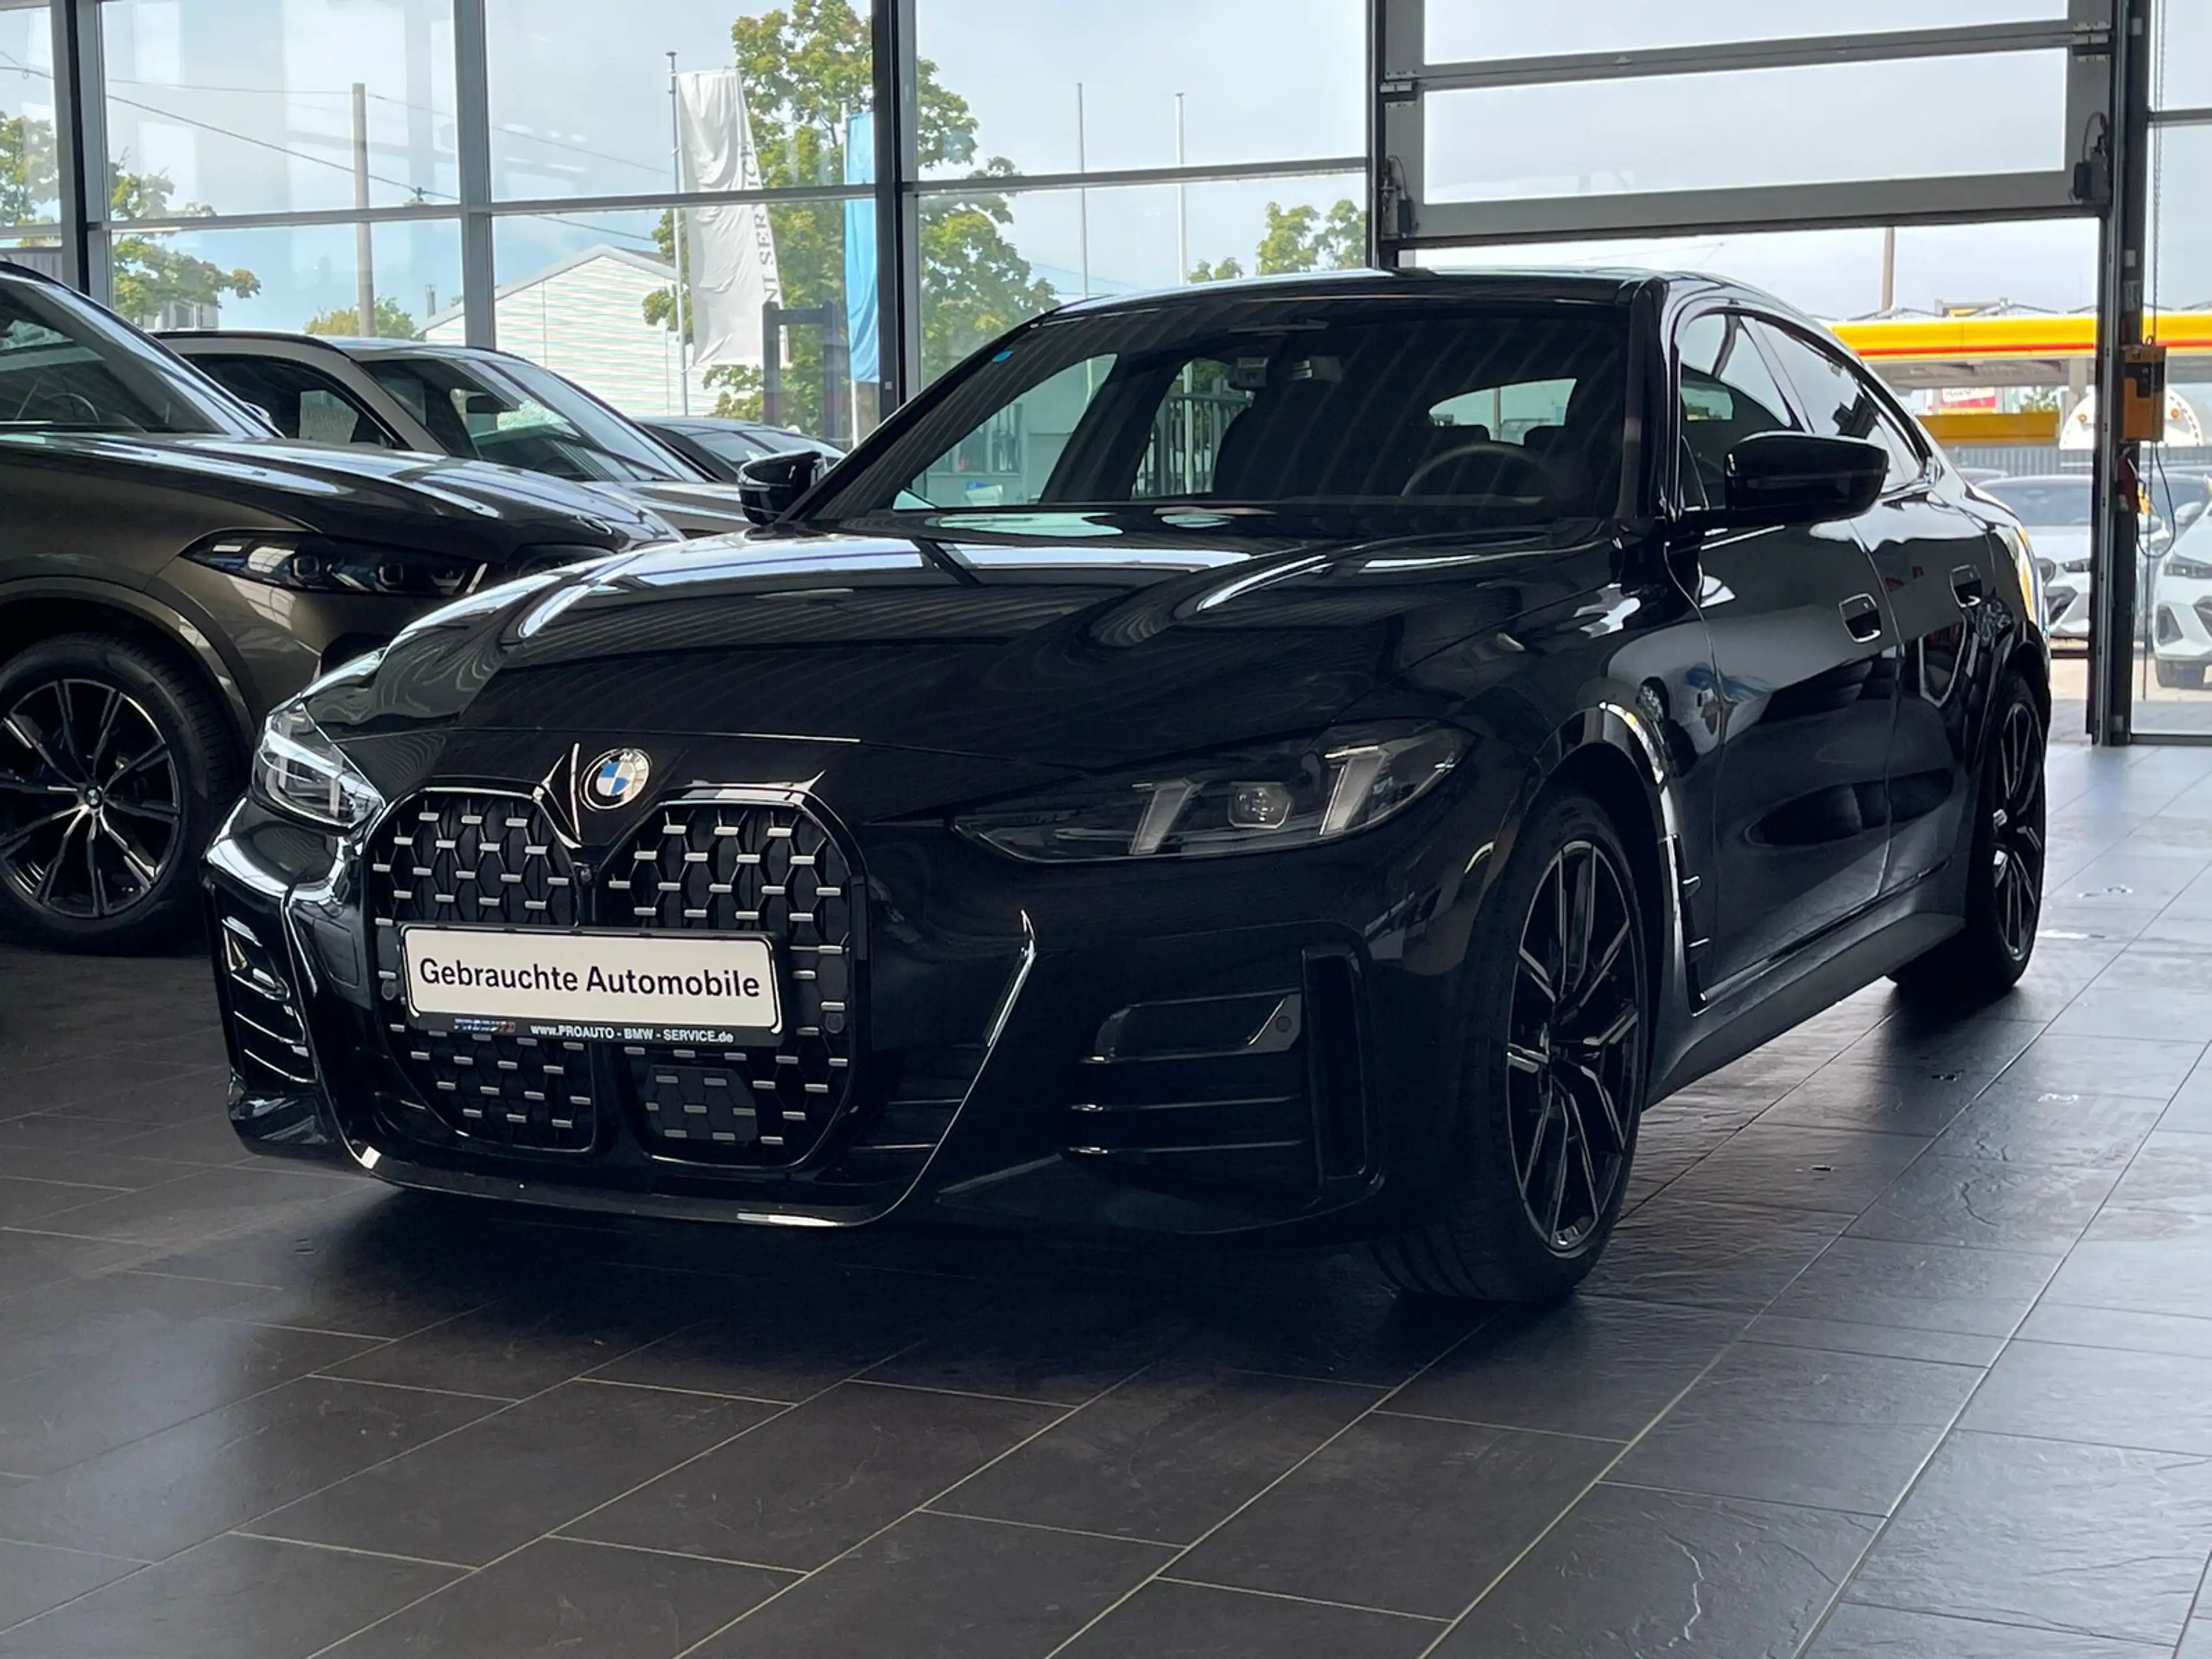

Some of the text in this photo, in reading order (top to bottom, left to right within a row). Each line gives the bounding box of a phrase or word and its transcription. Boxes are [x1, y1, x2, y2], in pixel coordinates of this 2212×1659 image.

[739, 142, 774, 266] SERICE
[419, 957, 760, 998] Gebrauchte Automobile
[530, 1025, 615, 1039] www.PROAUTO
[623, 1028, 653, 1040] BMW
[663, 1028, 734, 1043] SERVICE.de
